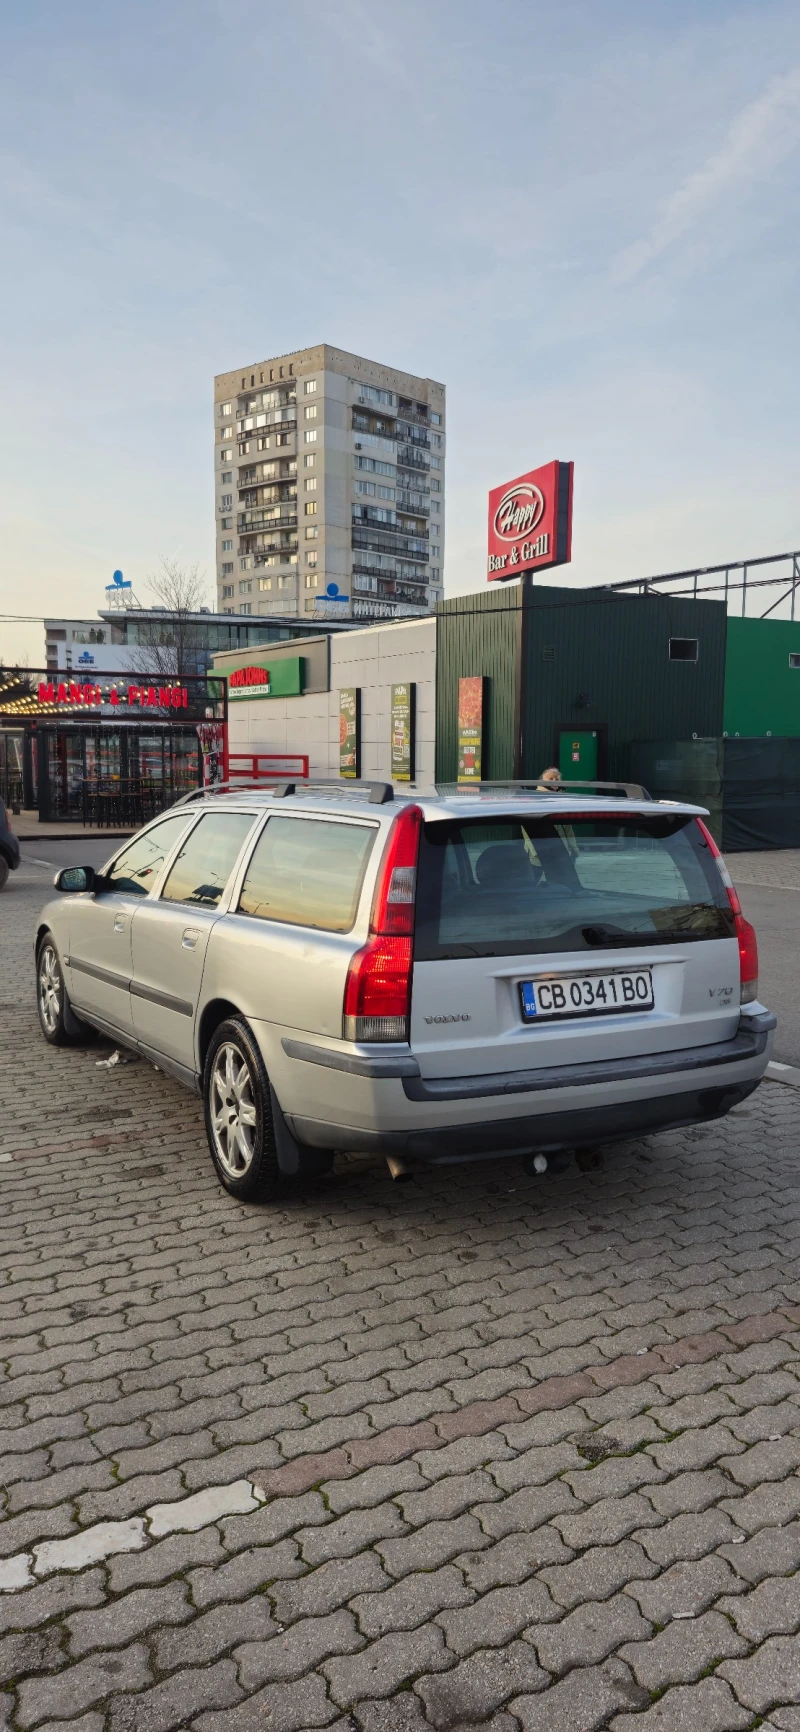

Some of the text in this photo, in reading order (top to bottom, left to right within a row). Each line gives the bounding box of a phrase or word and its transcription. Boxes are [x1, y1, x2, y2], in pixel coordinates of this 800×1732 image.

[499, 500, 537, 533] Happy
[487, 533, 549, 572] Bar & Grill
[38, 682, 188, 708] MANGI & PIANGI
[525, 1003, 536, 1012] BG
[537, 976, 649, 1010] CB 0341 BO
[424, 1013, 472, 1025] VOLVO
